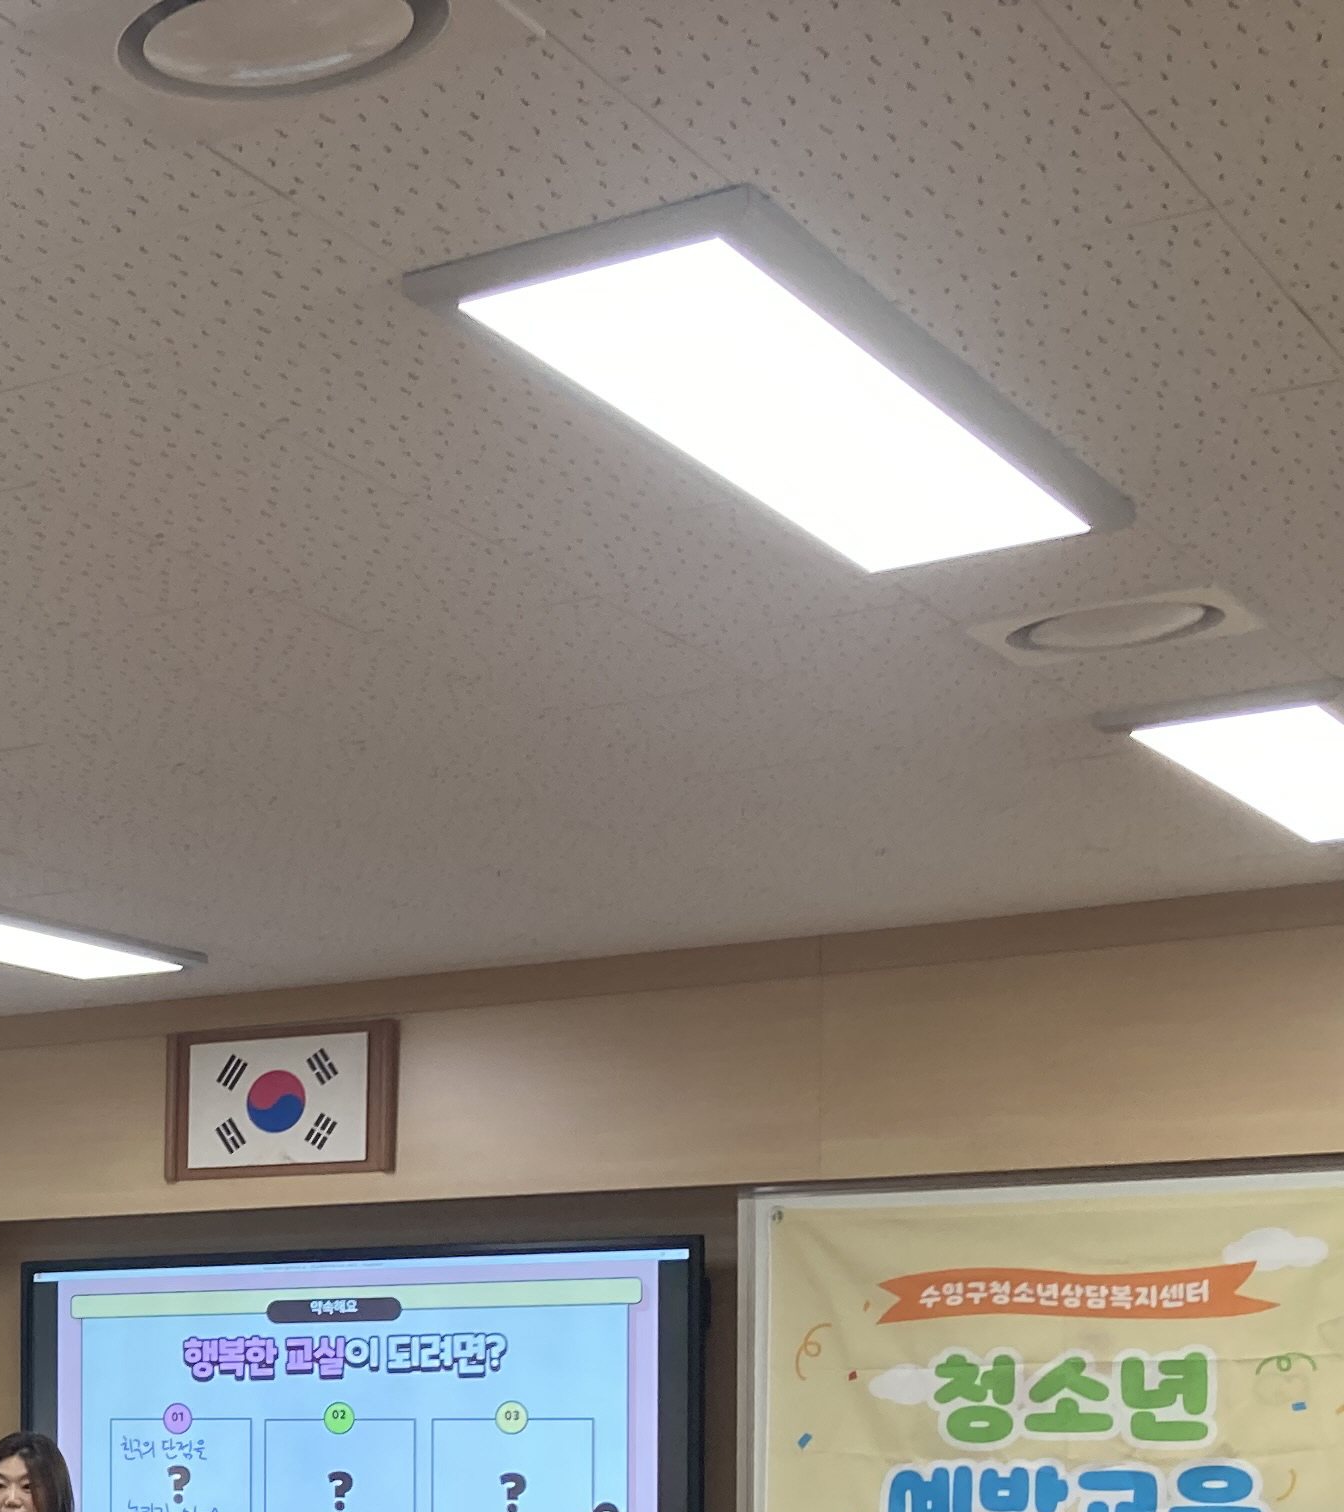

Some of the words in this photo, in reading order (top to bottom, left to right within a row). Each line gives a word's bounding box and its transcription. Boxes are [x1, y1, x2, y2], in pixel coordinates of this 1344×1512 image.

[310, 1299, 359, 1315] 약속해요
[919, 1278, 1210, 1310] 수영구청소년상담복지센터
[182, 1334, 279, 1382] 행복한
[285, 1335, 380, 1380] 교실이
[386, 1332, 509, 1379] 되려면?
[933, 1352, 1209, 1444] 청소년
[171, 1411, 184, 1422] 01
[331, 1409, 346, 1420] 02
[504, 1410, 520, 1421] 03
[120, 1435, 156, 1461] 친구의
[161, 1437, 207, 1461] 단점을
[166, 1464, 191, 1505] ?
[327, 1470, 354, 1512] ?
